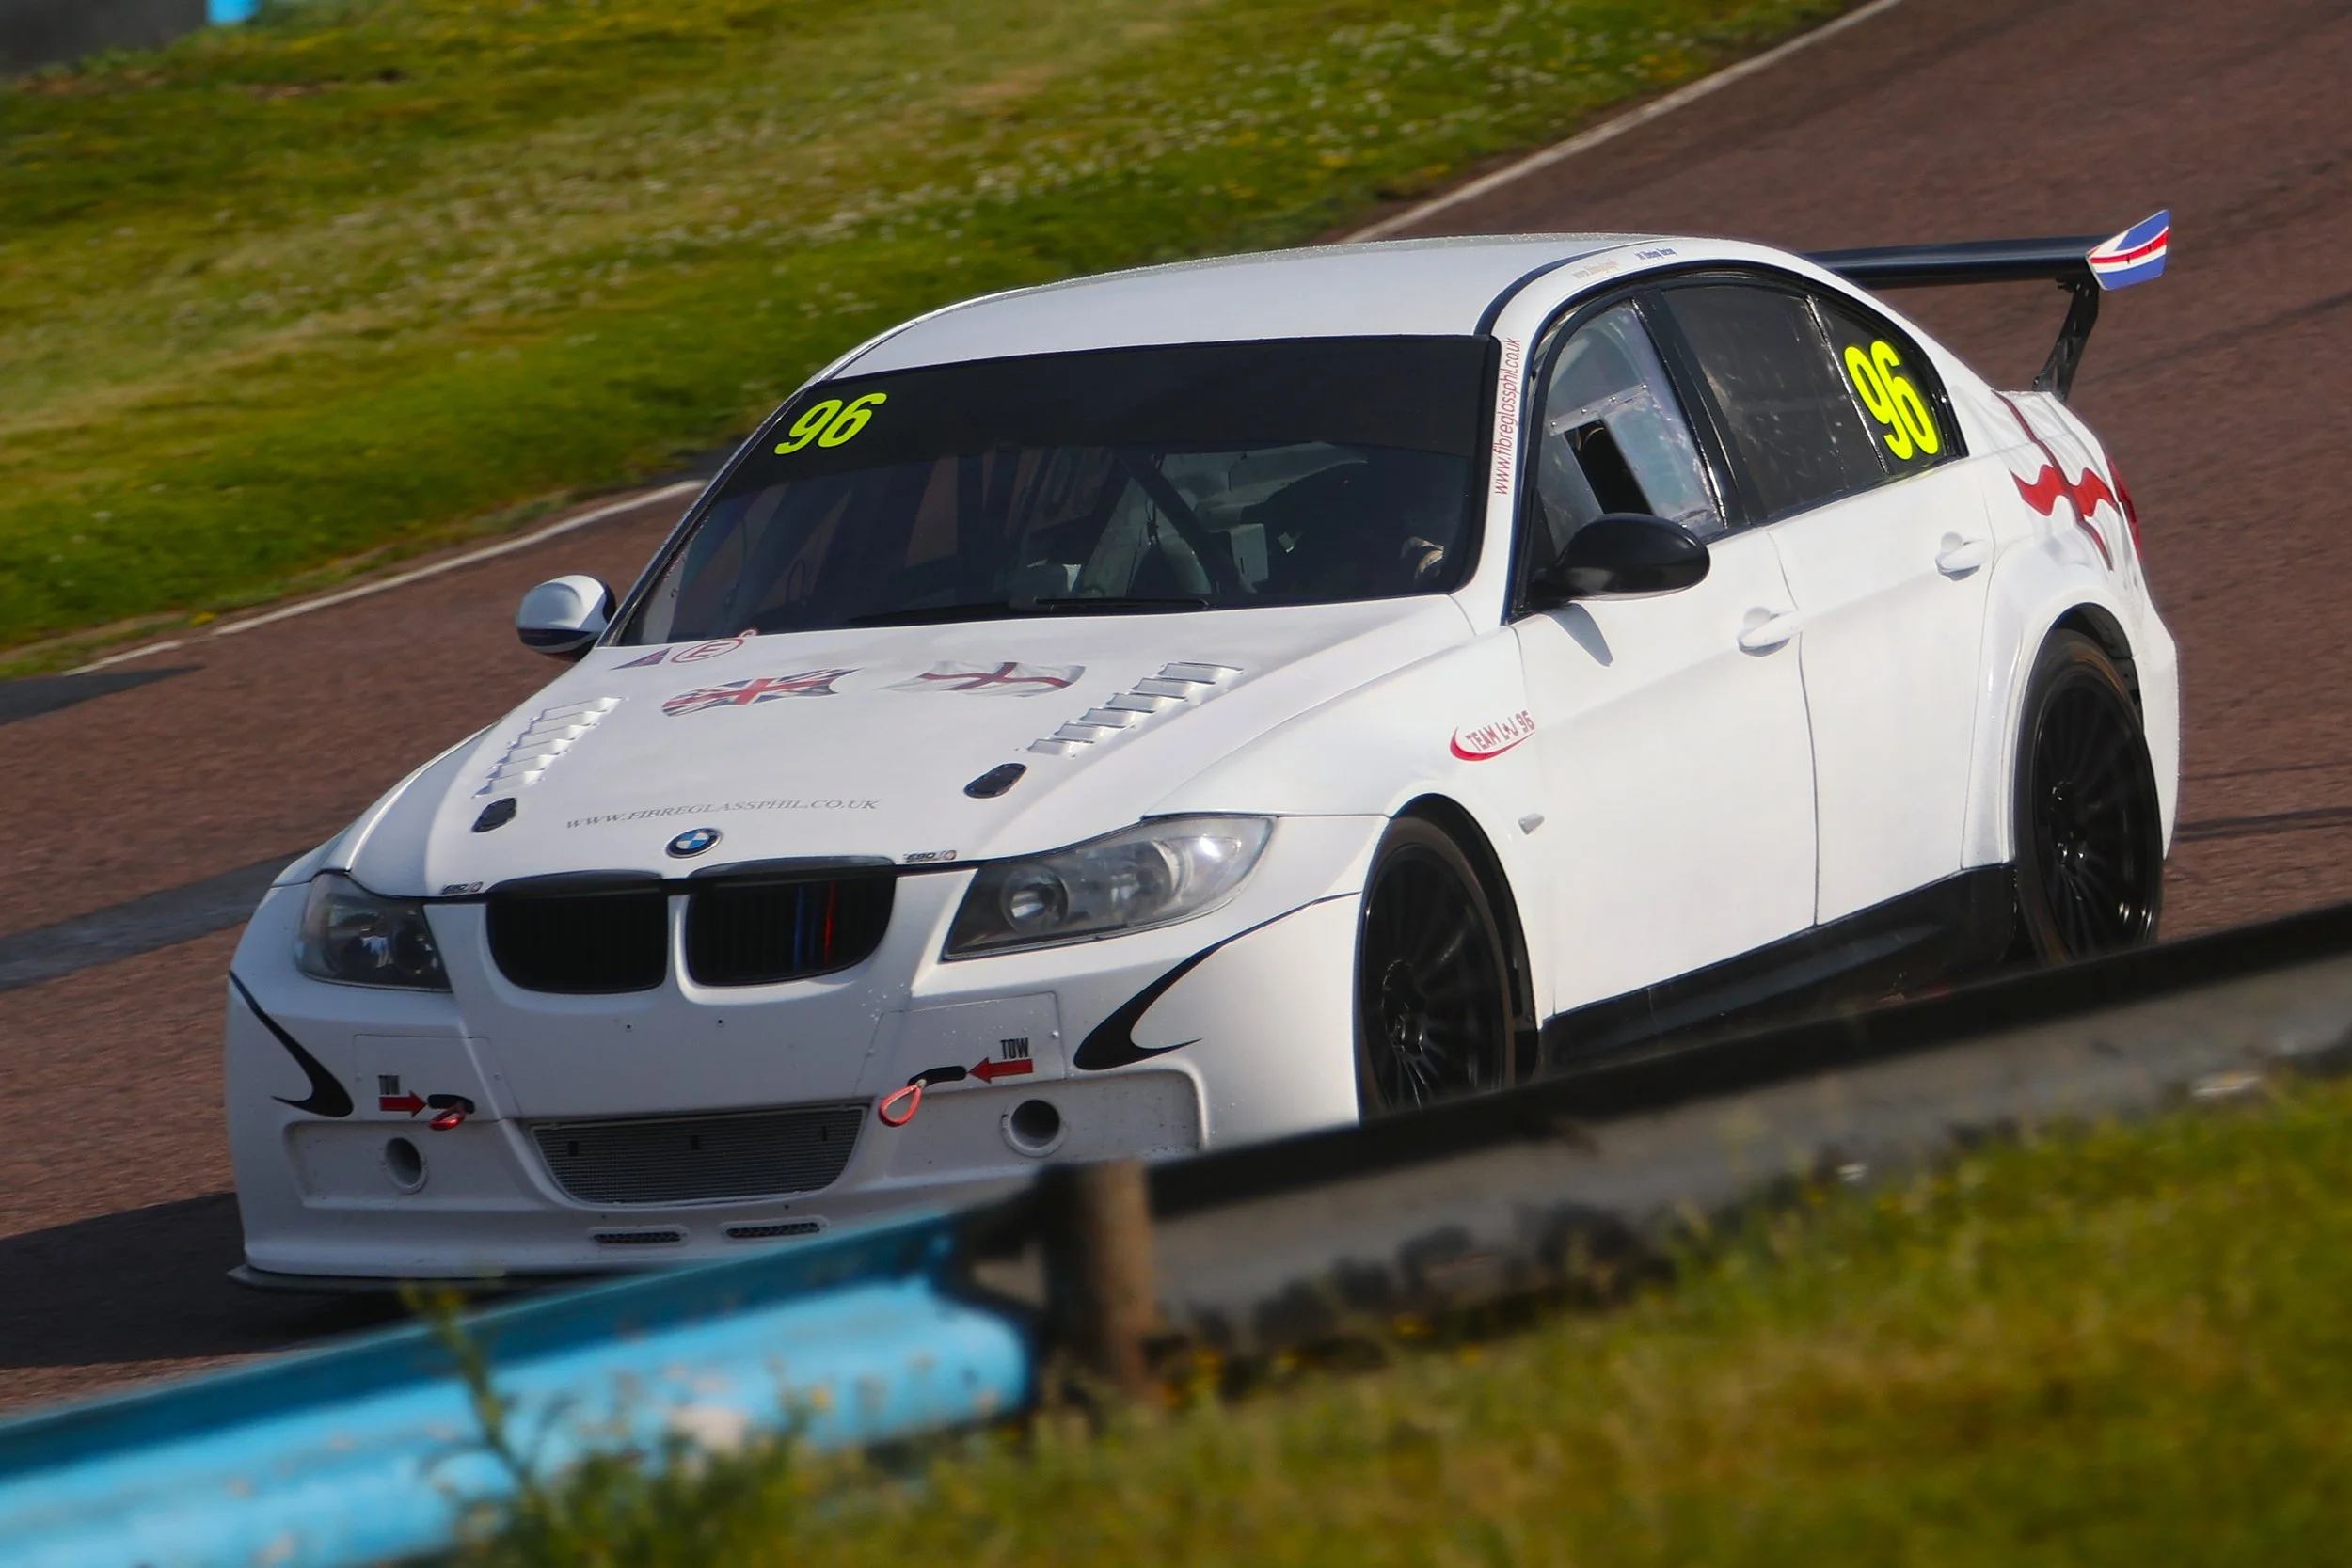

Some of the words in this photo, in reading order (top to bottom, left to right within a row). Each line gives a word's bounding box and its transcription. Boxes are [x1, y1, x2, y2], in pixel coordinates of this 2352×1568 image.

[773, 392, 887, 455] 96
[1493, 338, 1521, 495] www.fibreglassphil.co.uk
[1844, 341, 1939, 460] 96
[1465, 724, 1502, 752] TEAM
[1516, 709, 1536, 734] 96
[566, 800, 881, 829] WWW.FIBREGLASSPHIL.CO.UK
[1000, 1037, 1029, 1059] TOW
